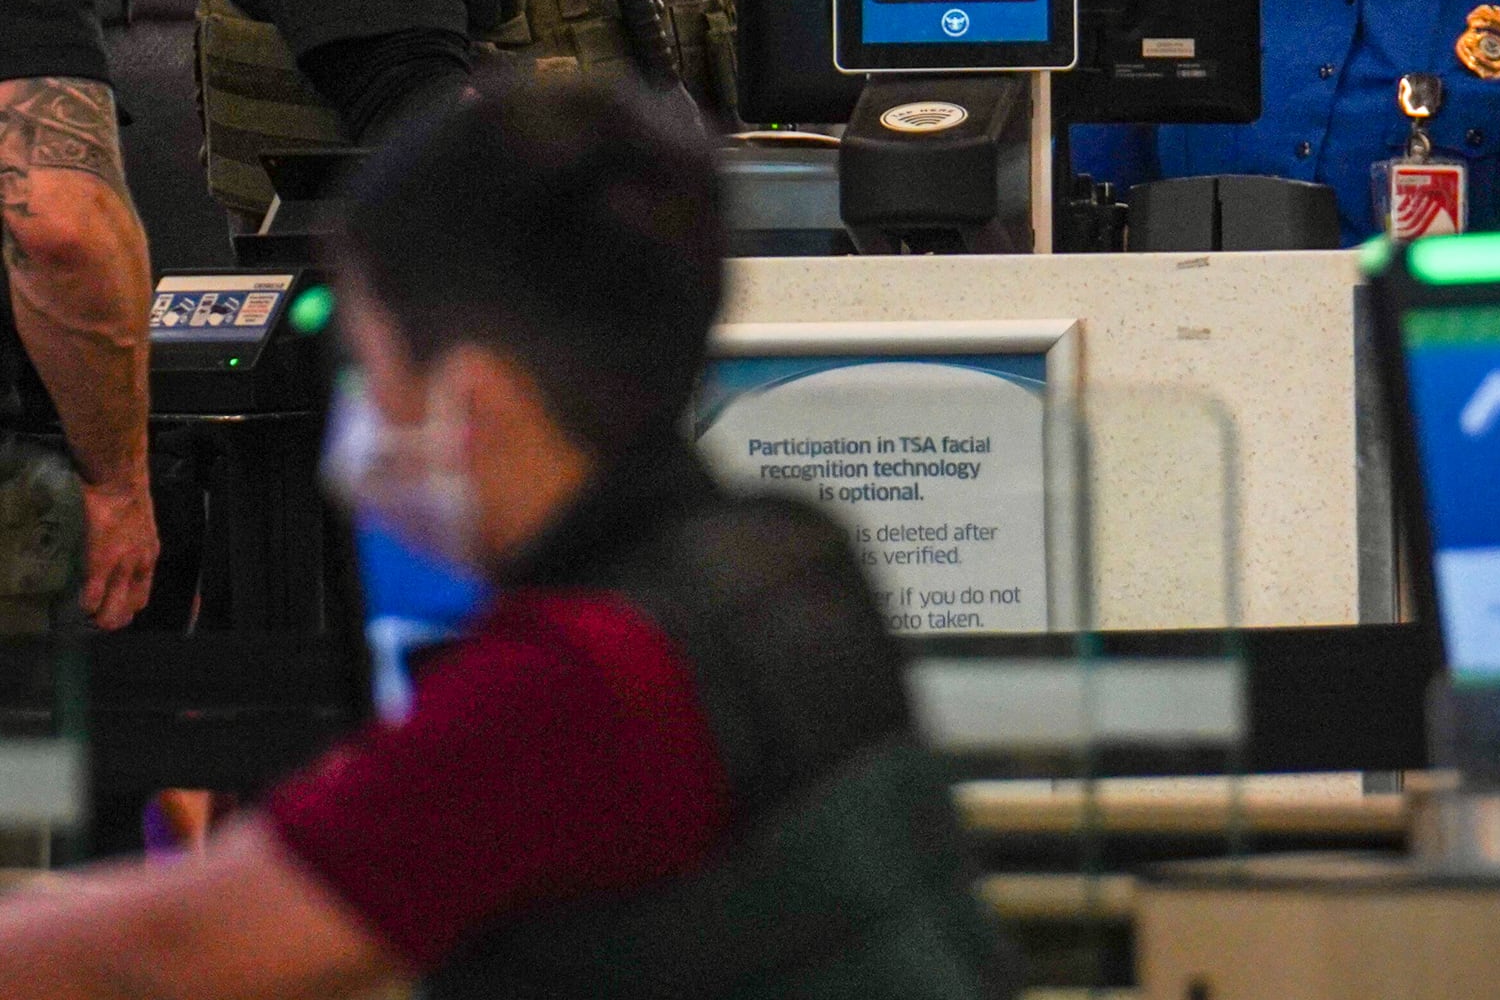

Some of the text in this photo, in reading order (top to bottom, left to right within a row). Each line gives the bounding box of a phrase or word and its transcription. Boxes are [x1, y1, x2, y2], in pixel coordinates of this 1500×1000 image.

[748, 436, 990, 458] Participation in TSA facial
[761, 459, 981, 481] recognition technology
[819, 483, 923, 503] is optional.
[856, 523, 998, 542] is deleted after
[862, 547, 962, 566] is verified.
[901, 587, 913, 605] if
[920, 589, 955, 608] you
[960, 586, 984, 604] do
[990, 586, 1021, 604] not
[884, 610, 984, 630] oto taken.
